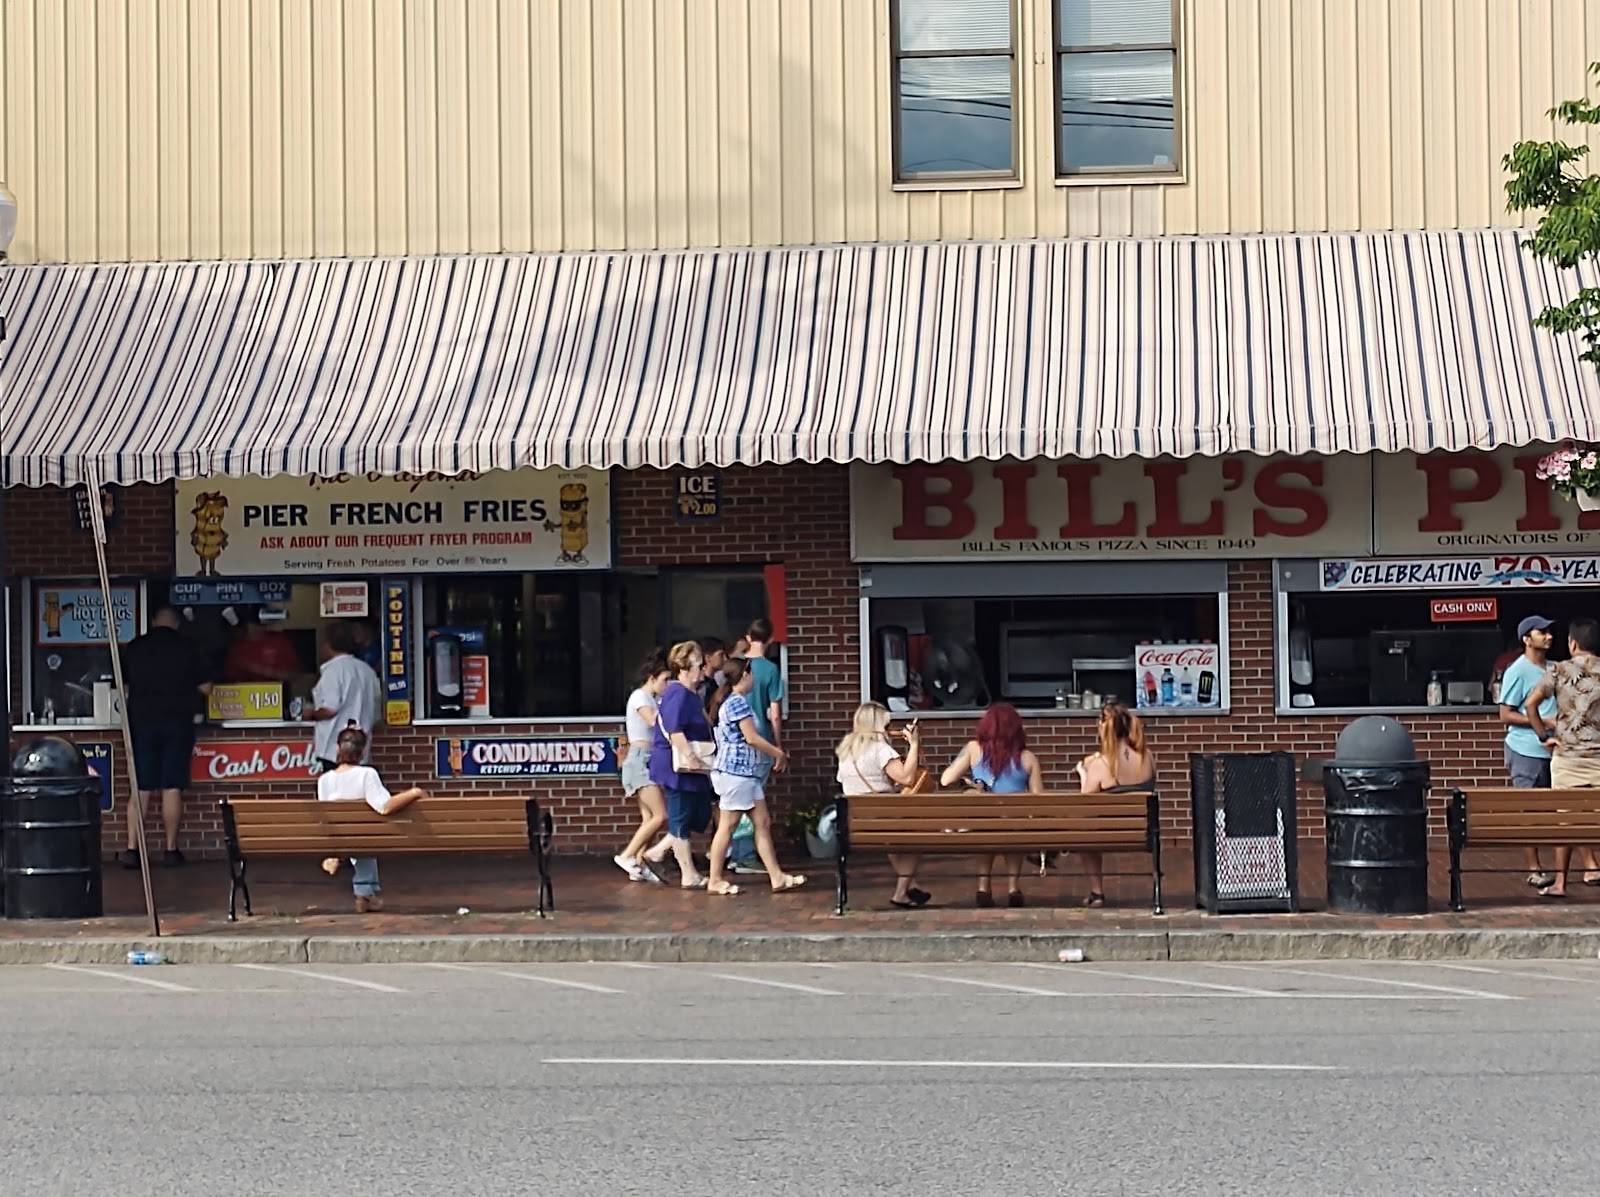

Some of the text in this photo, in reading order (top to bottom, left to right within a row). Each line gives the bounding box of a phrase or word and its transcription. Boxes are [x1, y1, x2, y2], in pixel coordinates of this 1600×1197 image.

[680, 476, 717, 493] ICE
[893, 459, 1329, 540] BILL'S
[243, 499, 547, 527] PIER FRENCH FRIES
[260, 532, 532, 549] ASK ABOUT OUR FREQUENT FRYER PROGRAM
[962, 538, 1255, 552] BILLS FAMOUS PIZZA SINCE 1949
[1437, 532, 1590, 546] ORIGINATORS OF
[284, 560, 323, 570] Serving
[327, 559, 355, 568] Fresh
[361, 557, 406, 568] Potatoes
[412, 557, 429, 566] For
[436, 556, 460, 566] Over
[480, 556, 508, 565] Years
[1351, 562, 1483, 584] CELEBRATING
[1561, 559, 1600, 579] YEA
[175, 582, 287, 593] CUP PINT BOX
[72, 607, 133, 621] HOT DGS
[1434, 602, 1493, 613] CASH ONLY
[472, 741, 606, 763] CONDIMENTS
[208, 743, 323, 778] Cash Only
[480, 763, 598, 774] KETCHUP SALT VINEGAR
